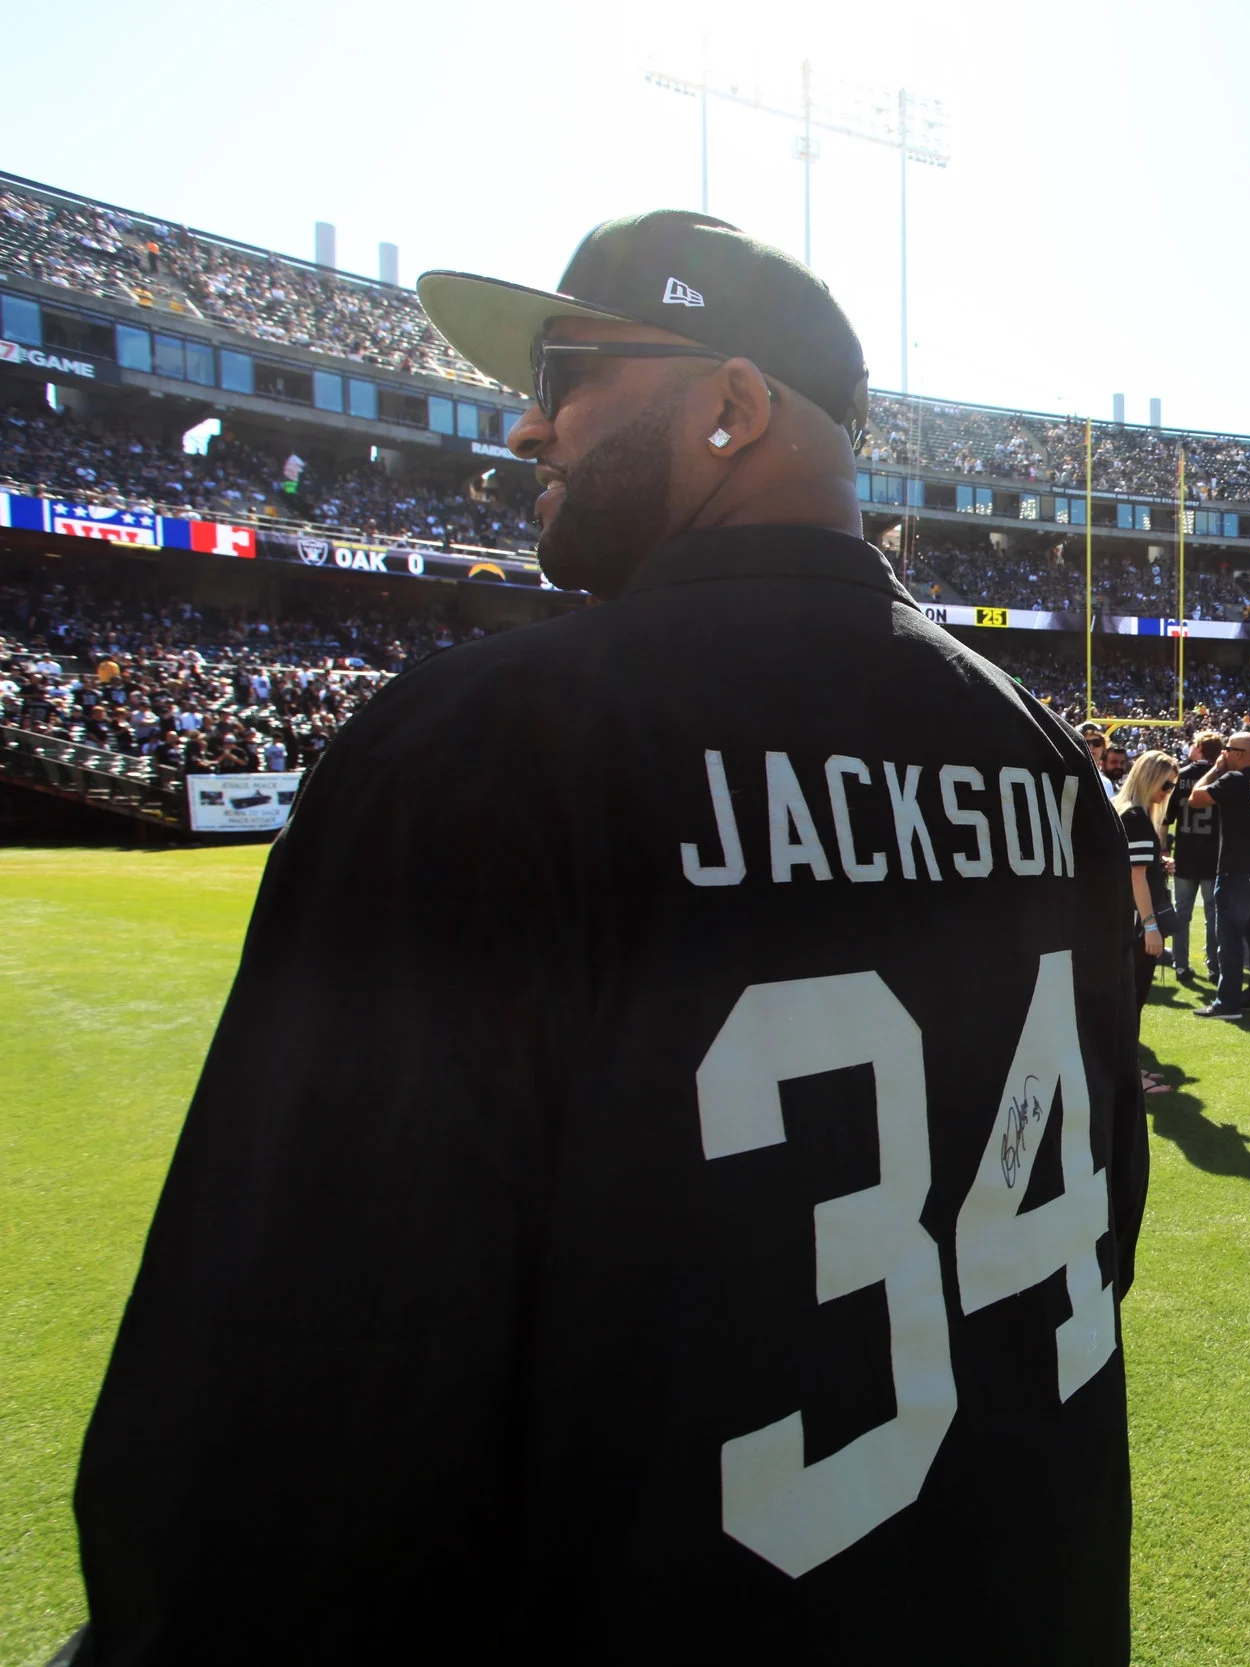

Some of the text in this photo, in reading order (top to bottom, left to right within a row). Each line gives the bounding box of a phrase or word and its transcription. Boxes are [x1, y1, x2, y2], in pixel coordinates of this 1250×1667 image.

[28, 350, 96, 378] GAME
[335, 548, 424, 575] OAK 0
[982, 609, 1003, 625] 25
[680, 749, 1079, 887] JACKSON
[1180, 797, 1212, 834] 12
[696, 950, 1117, 1579] 34
